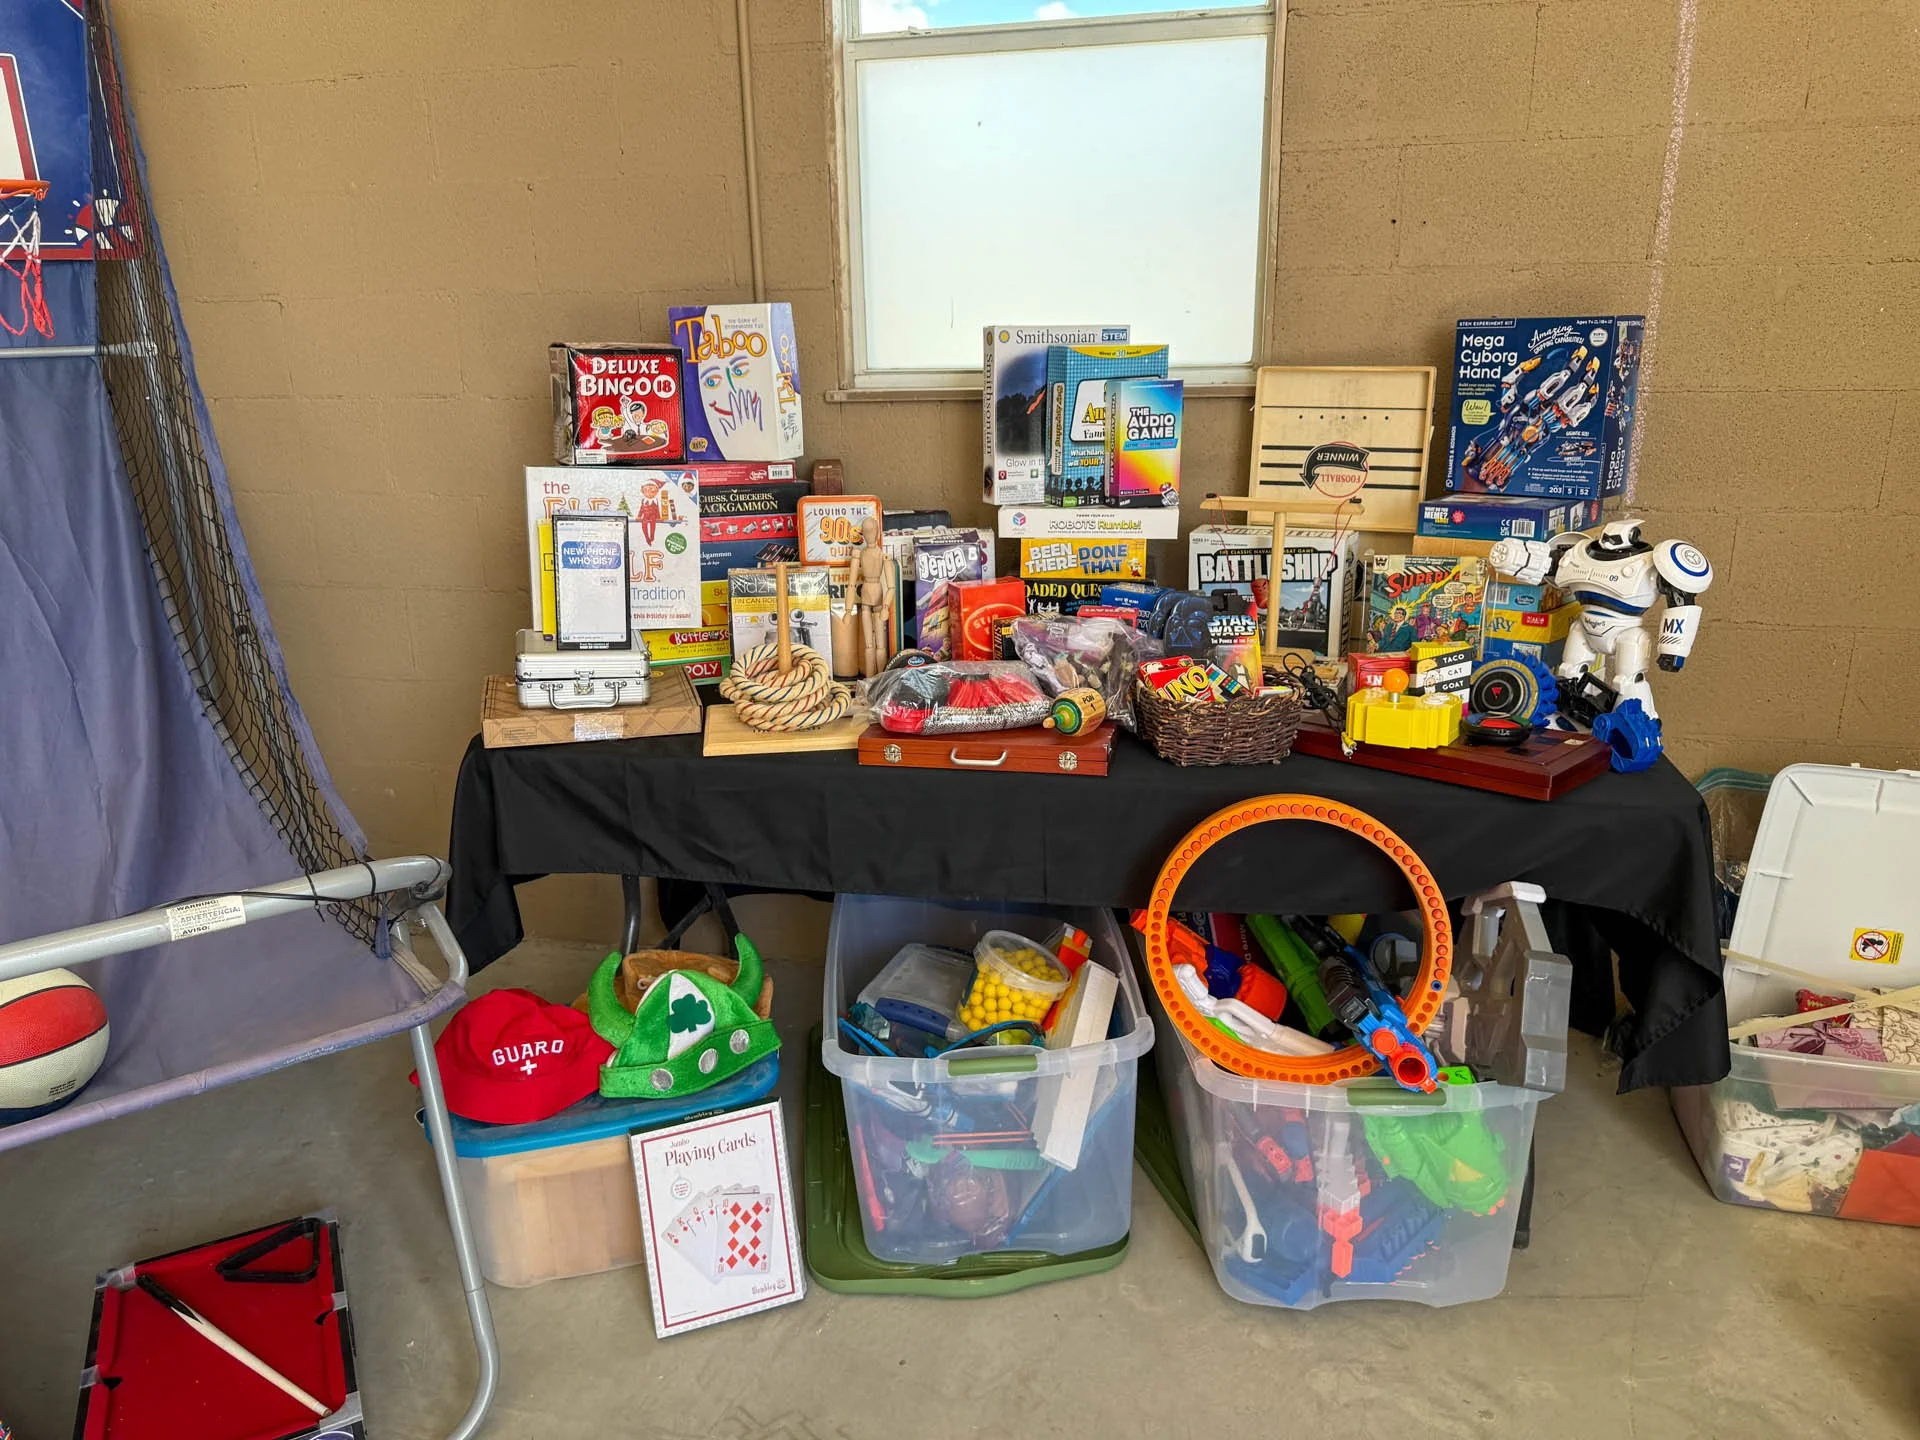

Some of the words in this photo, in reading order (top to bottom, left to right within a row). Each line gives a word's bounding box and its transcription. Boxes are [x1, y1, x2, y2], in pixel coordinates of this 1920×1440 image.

[674, 314, 768, 364] Taboo
[1016, 329, 1097, 344] Smithsonian
[1102, 330, 1128, 341] STEM
[1462, 334, 1504, 350] Mega
[1528, 326, 1574, 348] Amazing
[1460, 350, 1518, 365] Cyborg
[591, 356, 660, 375] DELUXE
[776, 335, 796, 414] Taboo
[1459, 366, 1501, 379] Hand
[578, 374, 652, 397] BINGO
[986, 353, 994, 456] Smithsonian
[1130, 407, 1149, 416] THE
[1128, 414, 1174, 428] AUDIO
[1128, 427, 1174, 440] GAME
[1006, 458, 1026, 467] Glow
[1316, 452, 1360, 462] WINNER
[1320, 474, 1360, 484] FOOSBALL
[544, 482, 570, 494] the
[730, 492, 775, 502] CHECKERS,
[813, 508, 846, 516] LOVING
[819, 516, 863, 544] 90s
[1050, 520, 1096, 530] ROBOTS
[1097, 520, 1142, 530] Rumble!
[563, 547, 585, 556] NEW
[1030, 543, 1073, 560] BEEN
[1078, 544, 1128, 561] DONE
[568, 556, 592, 564] WHO
[919, 548, 967, 583] Jenga
[1025, 555, 1078, 575] THERE
[1080, 560, 1122, 575] THAT
[1200, 553, 1336, 582] BATTLSHIP
[632, 588, 686, 601] Tradition
[1207, 616, 1256, 626] STAR
[1662, 618, 1682, 634] MX
[1208, 626, 1256, 637] WARS
[674, 631, 709, 646] Battle
[1443, 654, 1465, 664] TACO
[1448, 668, 1463, 676] CAT
[1158, 666, 1209, 702] UNO
[1366, 676, 1383, 686] IN
[1441, 680, 1464, 690] GOAT
[176, 900, 218, 912] WARNING:
[180, 906, 240, 923] ADVERTENCIA:
[182, 926, 210, 936] AVISO:
[492, 1040, 564, 1066] GUARD
[665, 1144, 716, 1167] Playing
[717, 1132, 756, 1156] Cards
[669, 1138, 690, 1149] Jumbo
[722, 1198, 729, 1208] 10
